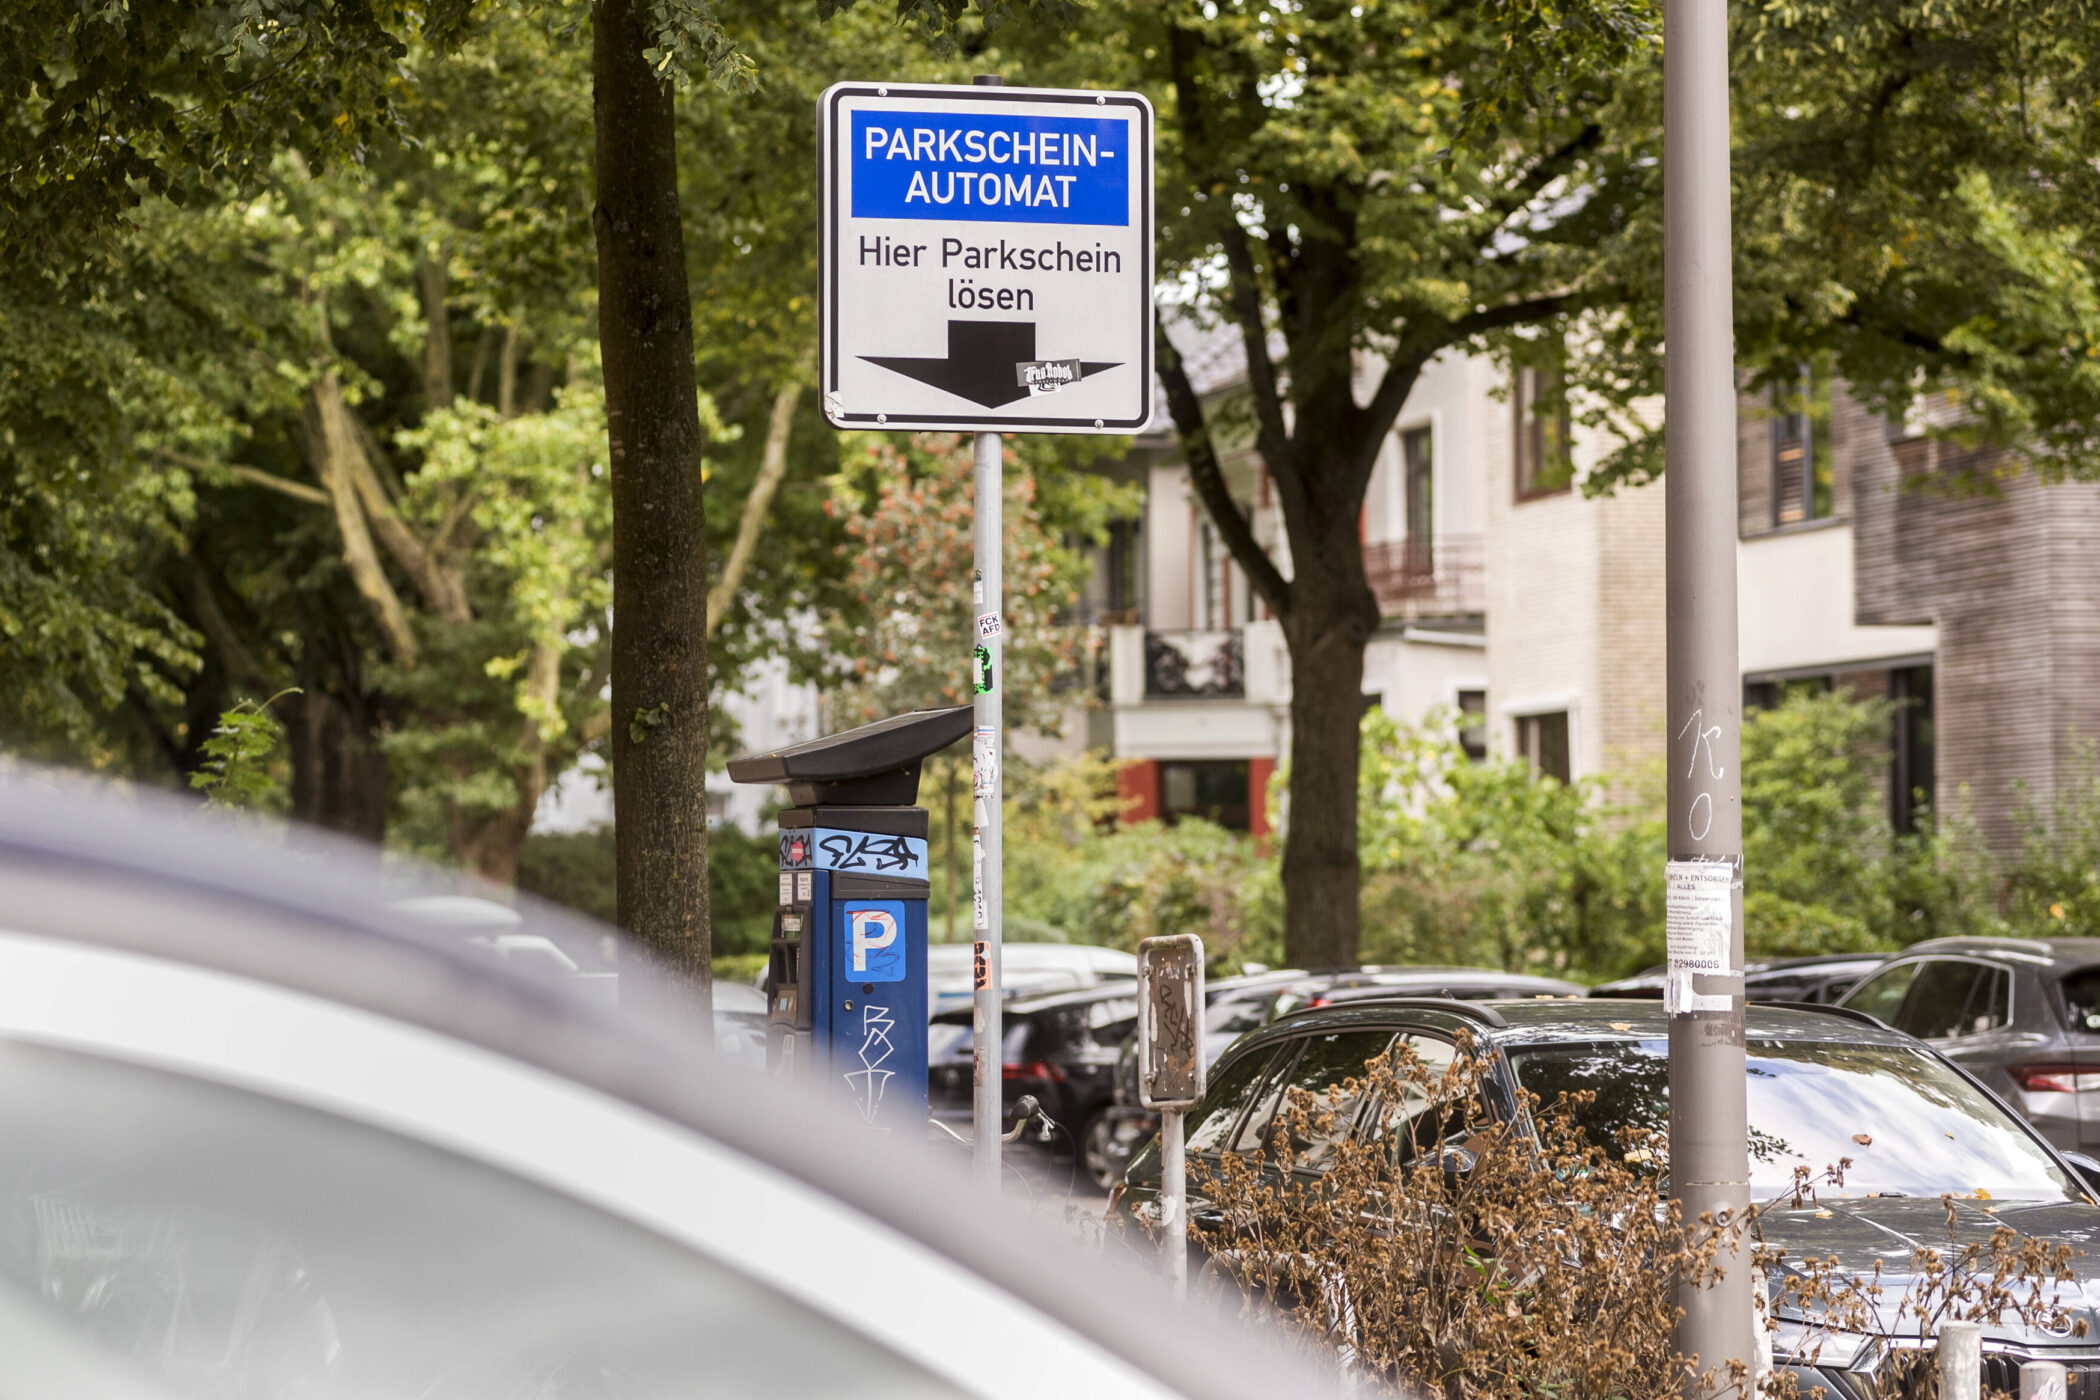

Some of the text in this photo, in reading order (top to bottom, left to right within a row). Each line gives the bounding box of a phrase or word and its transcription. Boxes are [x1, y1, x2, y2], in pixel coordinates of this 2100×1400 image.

[865, 127, 1115, 167] PARKSCHEIN-
[905, 170, 1077, 208] AUTOMAT
[859, 235, 1121, 273] Hier Parkschein
[948, 278, 1034, 311] lösen
[979, 615, 999, 627] FCK
[982, 623, 1000, 635] AFD
[853, 911, 898, 972] P
